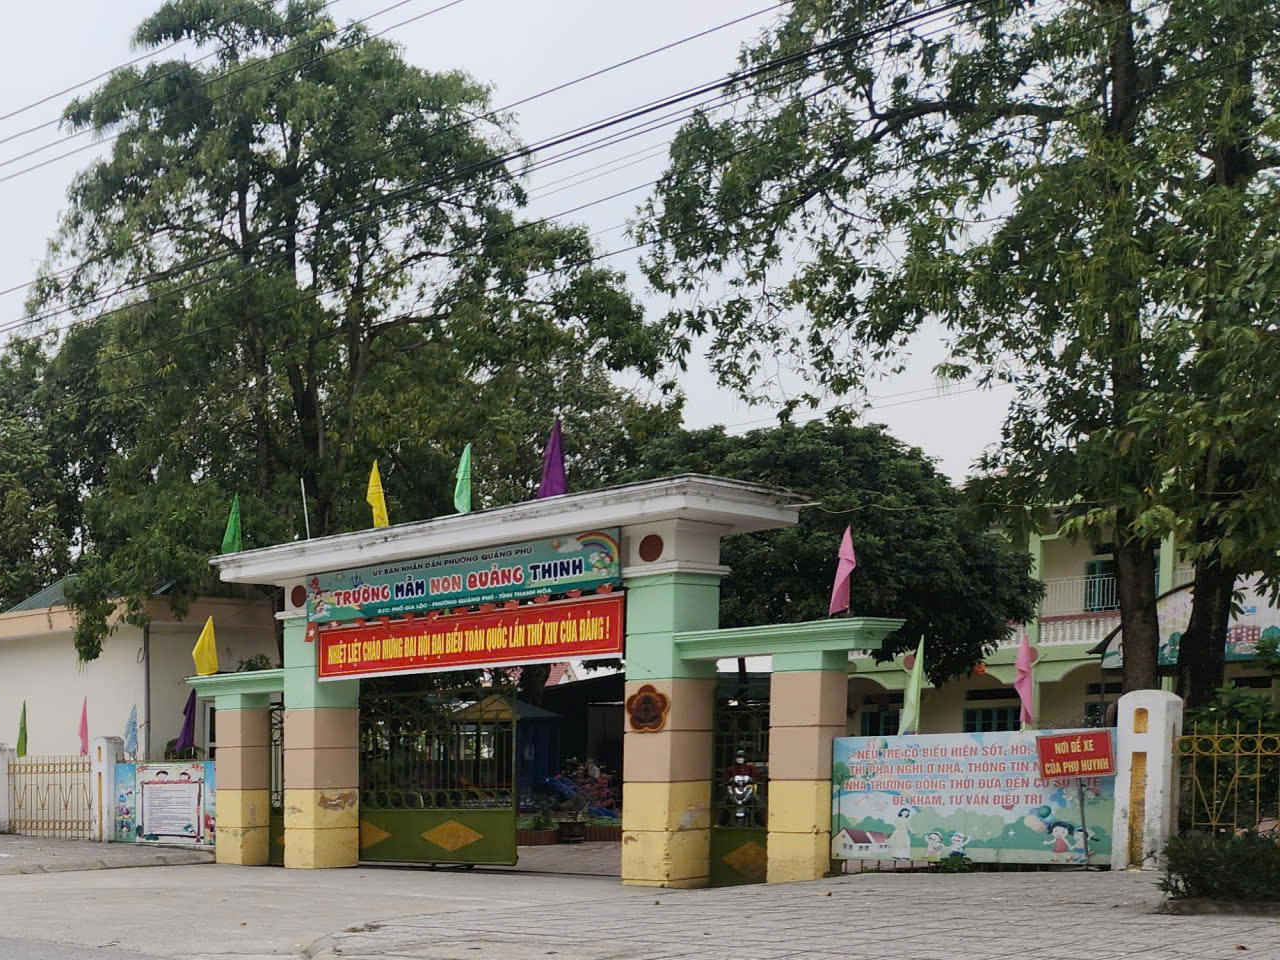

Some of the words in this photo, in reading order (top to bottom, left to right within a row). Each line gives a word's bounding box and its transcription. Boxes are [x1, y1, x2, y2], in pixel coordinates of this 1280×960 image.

[384, 567, 400, 576] BAN
[401, 562, 424, 573] NHÂN
[425, 560, 442, 569] DÂN
[444, 553, 479, 566] PHƯỜNG
[481, 549, 513, 561] QUẢNG
[514, 545, 533, 556] PHÚ
[334, 584, 390, 606] TRƯỜNG
[394, 575, 425, 599] MẦM
[430, 575, 462, 595] NON
[467, 564, 523, 590] QUẢNG
[529, 558, 584, 582] THỊNH
[416, 601, 428, 610] LỘC
[481, 593, 495, 601] PHÚ
[514, 590, 536, 598] THANH
[328, 640, 347, 668] NHIỆT
[347, 638, 362, 667] LIỆT
[363, 636, 381, 661] CHÀO
[382, 634, 404, 659] MỪNG
[404, 635, 417, 662] ĐẠI
[418, 630, 430, 660] HỘI
[431, 633, 445, 659] ĐẠI
[445, 622, 463, 654] BIỂU
[465, 624, 485, 652] TOÀN
[486, 619, 508, 652] QUỐC
[509, 617, 525, 648] LẦN
[527, 618, 544, 646] THỨ
[544, 621, 559, 645] XIV
[560, 612, 578, 644] CỦA
[579, 610, 604, 642] ĐẢNG
[951, 744, 978, 758] HIỆN
[1054, 741, 1069, 755] NƠI
[1071, 736, 1082, 753] ĐỂ
[1083, 739, 1095, 752] XE
[968, 760, 1006, 773] THÔNG
[1011, 761, 1029, 772] TIN
[1044, 758, 1061, 775] CỦA
[1063, 760, 1079, 775] PHỤ
[1081, 758, 1109, 772] HUYNH
[978, 777, 1002, 789] ĐƯA
[949, 795, 965, 806] TƯ
